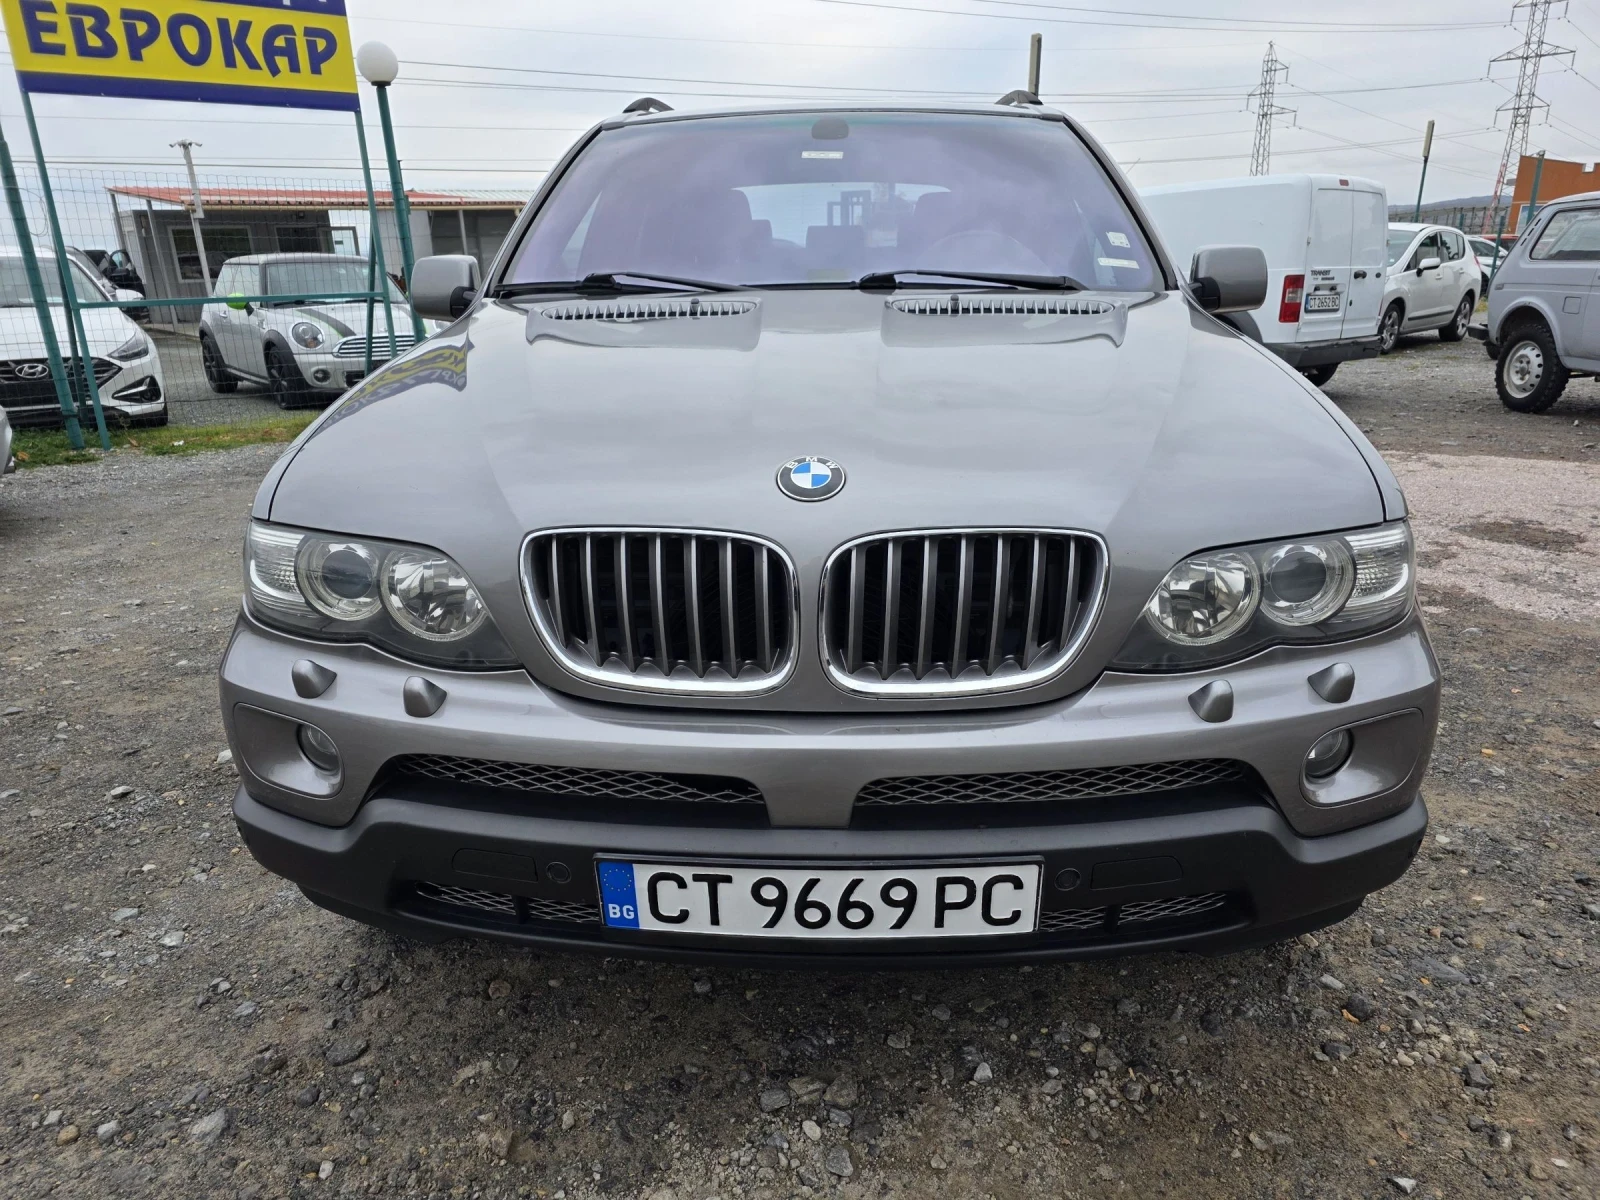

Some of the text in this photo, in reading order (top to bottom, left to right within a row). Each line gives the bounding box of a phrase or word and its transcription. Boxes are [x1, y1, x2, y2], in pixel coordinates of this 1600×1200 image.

[19, 0, 338, 78] ЕВРОКАР
[785, 456, 839, 469] BMW
[608, 903, 636, 920] BG
[647, 871, 1024, 930] CT 9669 PC
